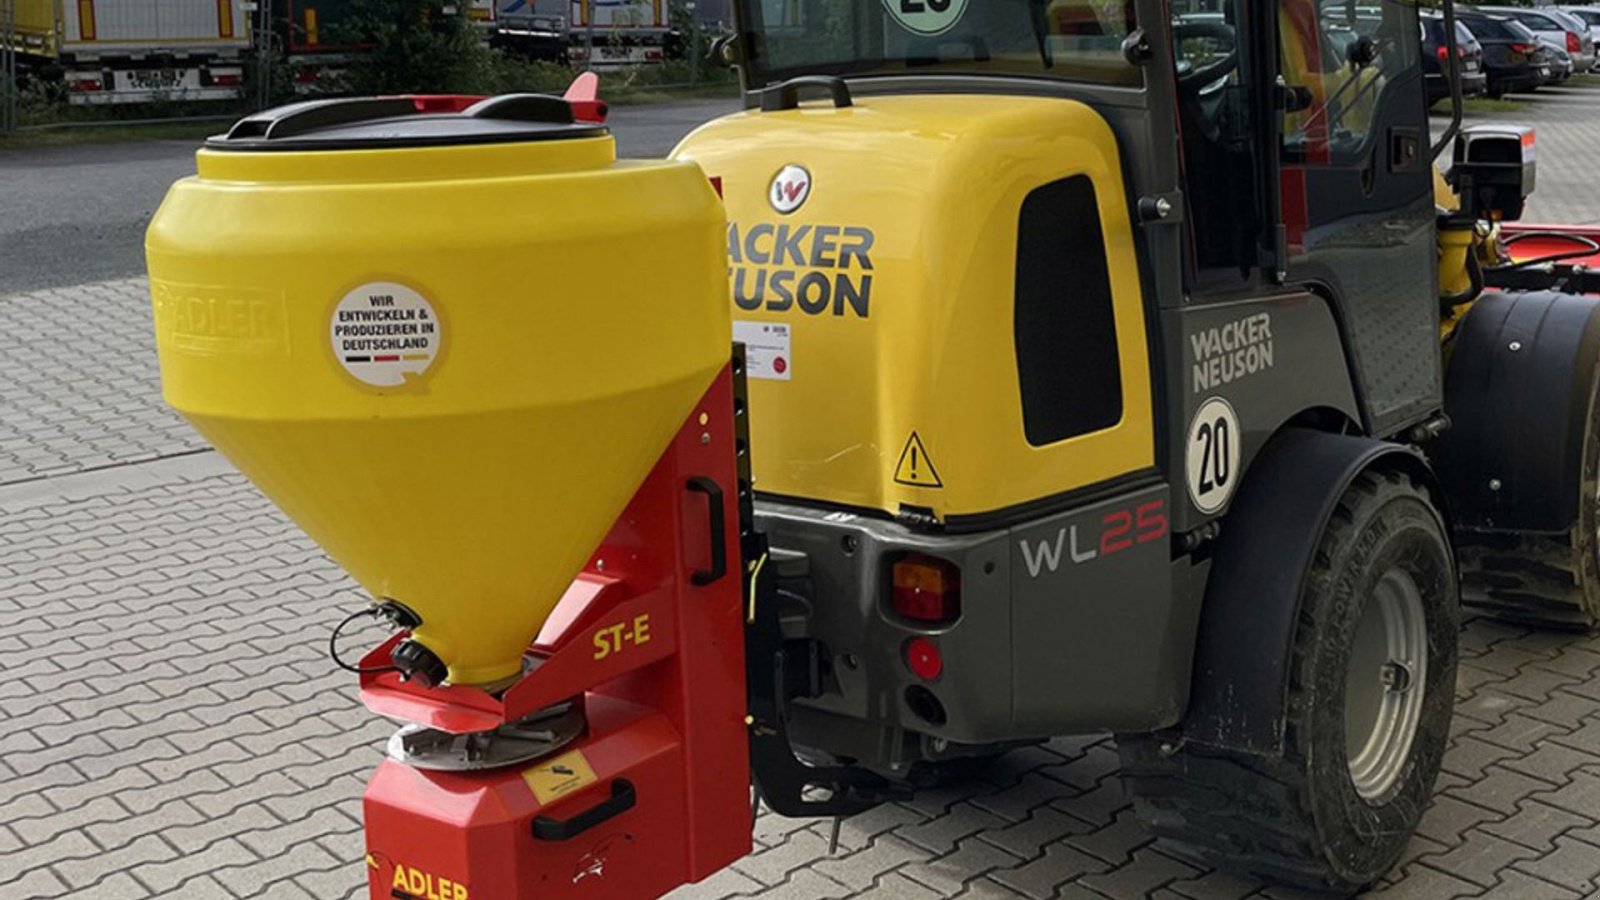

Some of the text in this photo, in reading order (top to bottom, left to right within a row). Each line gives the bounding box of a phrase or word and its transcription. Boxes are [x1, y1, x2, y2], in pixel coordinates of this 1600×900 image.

[727, 222, 875, 270] ACKER
[339, 308, 428, 322] ENTWICKELN &
[369, 295, 394, 306] WIR
[728, 266, 873, 318] USON
[335, 323, 434, 336] PRODUZIEREN IN
[343, 337, 429, 350] DEUTSCHLAND
[1190, 312, 1272, 361] WACKER
[1193, 340, 1273, 393] NEUSON
[1197, 416, 1229, 496] 20
[593, 613, 650, 660] ST-E
[392, 864, 468, 900] ADLER
